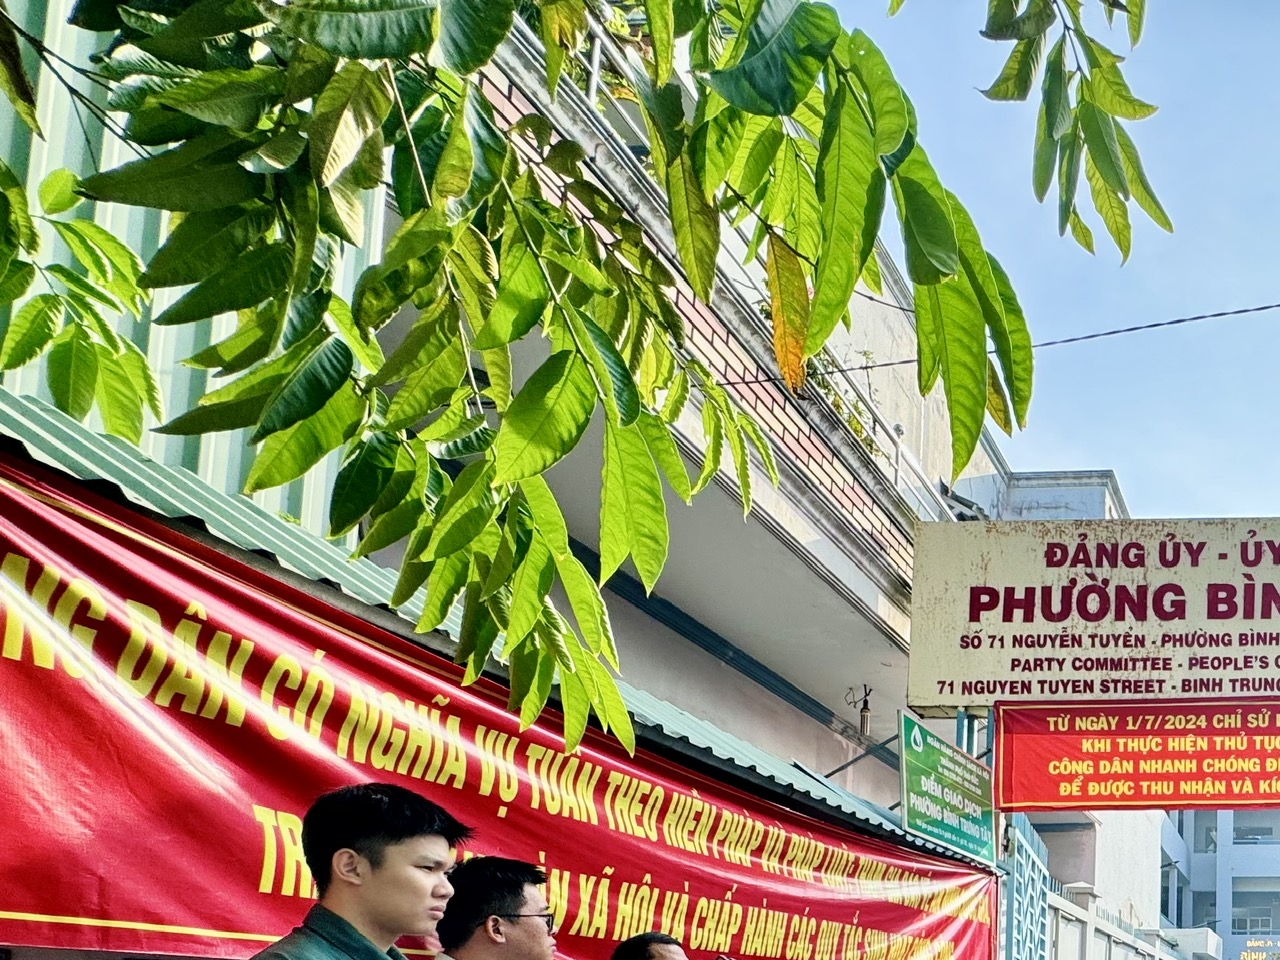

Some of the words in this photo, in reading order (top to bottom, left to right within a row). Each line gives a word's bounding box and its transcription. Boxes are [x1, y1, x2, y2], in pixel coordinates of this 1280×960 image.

[1044, 533, 1145, 568] ĐẢNG
[1158, 532, 1206, 568] ỦY
[968, 573, 1186, 622] PHƯỜNG
[960, 628, 984, 650] SỐ
[988, 635, 1004, 648] 71
[1012, 626, 1082, 648] NGUYỄN
[1160, 628, 1232, 648] PHƯỜNG
[1238, 628, 1280, 647] BÌNH
[1010, 658, 1066, 672] PARTY
[1072, 656, 1172, 671] COMMITTEE
[1188, 655, 1269, 671] PEOPLE'S
[937, 681, 954, 694] 71
[961, 680, 1032, 695] NGUYEN
[1038, 680, 1094, 694] TUYEN
[1100, 679, 1166, 694] STREET
[1181, 678, 1222, 693] BINH
[115, 598, 256, 728] DÂN
[260, 649, 336, 742] CÓ
[338, 683, 468, 790] NGHĨA
[474, 725, 520, 818] VỤ
[604, 770, 664, 842] THEO
[1047, 714, 1070, 731] TỪ
[1075, 714, 1119, 731] NGÀY
[1126, 714, 1207, 730] 1/7/2024
[1213, 709, 1242, 728] CHỈ
[1247, 709, 1271, 728] SỬ
[1082, 738, 1110, 752] KHI
[1116, 736, 1162, 754] THỰC
[1168, 734, 1208, 754] HIỆN
[1213, 732, 1248, 750] THỦ
[1048, 758, 1094, 775] CÔNG
[1100, 757, 1134, 774] DÂN
[1140, 759, 1196, 773] NHANH
[1202, 755, 1260, 773] CHÓNG
[1060, 776, 1084, 796] ĐỂ
[1088, 780, 1135, 797] ĐƯỢC
[1140, 781, 1174, 795] THU
[1180, 777, 1226, 796] NHẬN
[1232, 778, 1253, 794] VÀ
[944, 787, 963, 810] GIAO
[964, 800, 982, 820] DỊCH
[569, 867, 614, 938] XÃ
[662, 882, 689, 944] VÀ
[690, 884, 742, 953] CHẤP
[740, 898, 788, 958] HÀNH
